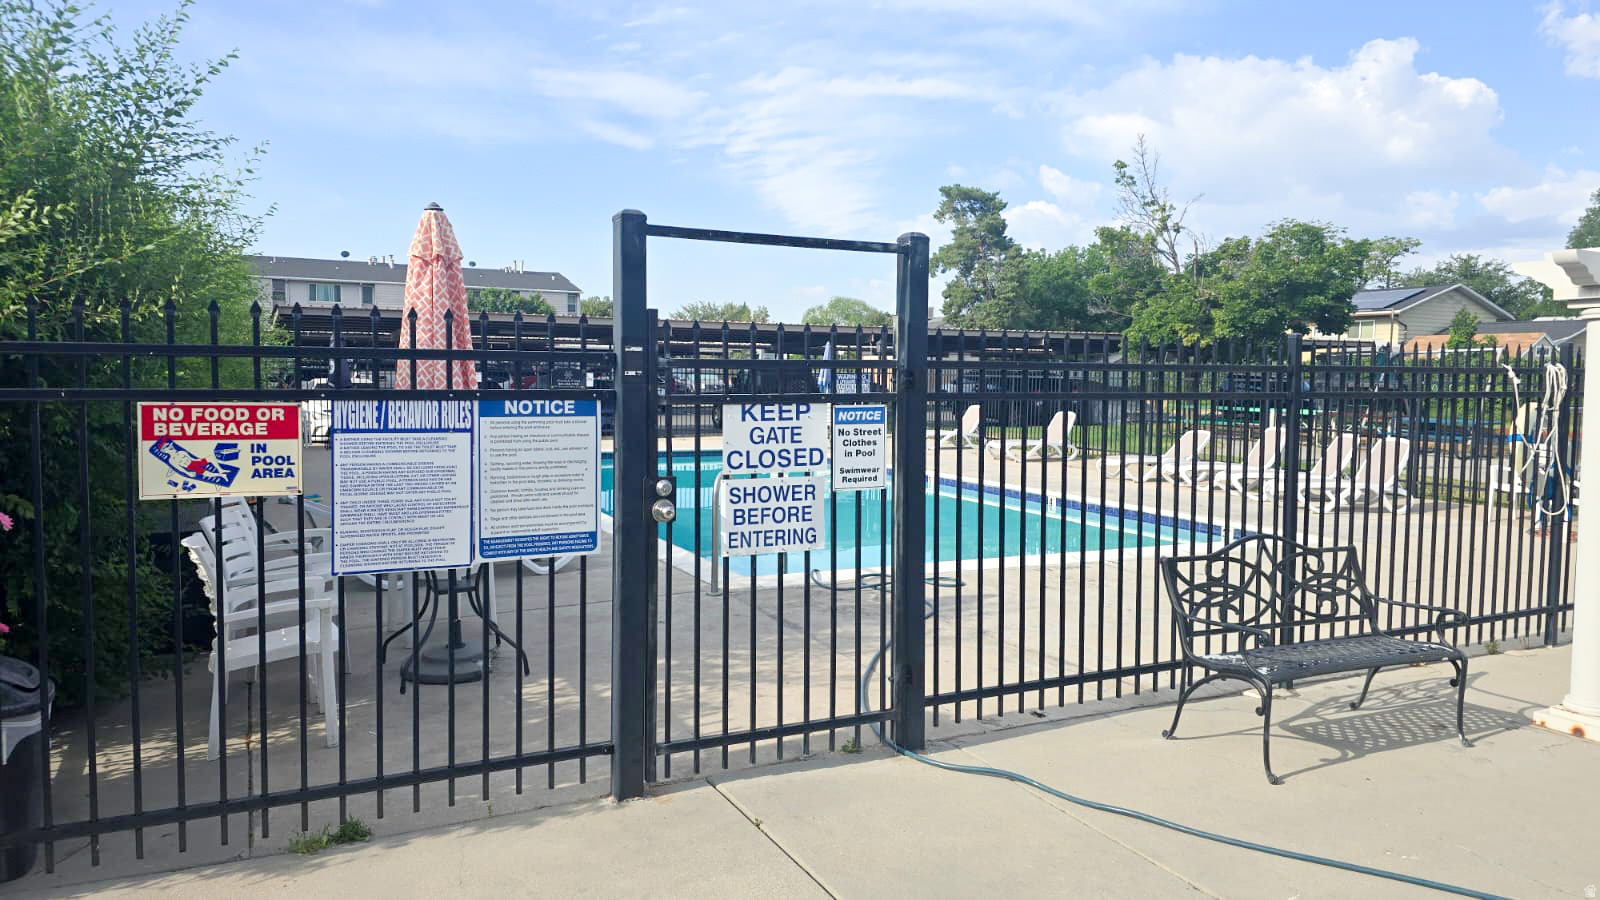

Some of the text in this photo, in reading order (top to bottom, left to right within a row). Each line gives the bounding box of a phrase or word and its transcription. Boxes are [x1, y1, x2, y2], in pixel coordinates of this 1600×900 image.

[153, 407, 285, 421] NO FOOD OR
[334, 400, 379, 429] HYGIENE
[388, 400, 439, 429] BEHAVIOR
[441, 400, 471, 429] RULES
[504, 400, 576, 415] NOTICE
[741, 403, 811, 422] KEEP
[838, 410, 882, 421] NOTICE
[153, 422, 268, 436] BEVERAGE
[749, 426, 803, 445] GATE
[838, 427, 882, 437] No Street
[251, 443, 267, 453] IN
[842, 438, 877, 447] Clothes
[252, 455, 295, 466] POOL
[726, 447, 824, 470] CLOSED
[844, 449, 876, 458] in Pool
[252, 468, 295, 479] AREA
[839, 466, 880, 475] Swimwear
[841, 475, 878, 484] Required
[729, 484, 816, 505] SHOWER
[733, 505, 813, 526] BEFORE
[728, 527, 817, 549] ENTERING
